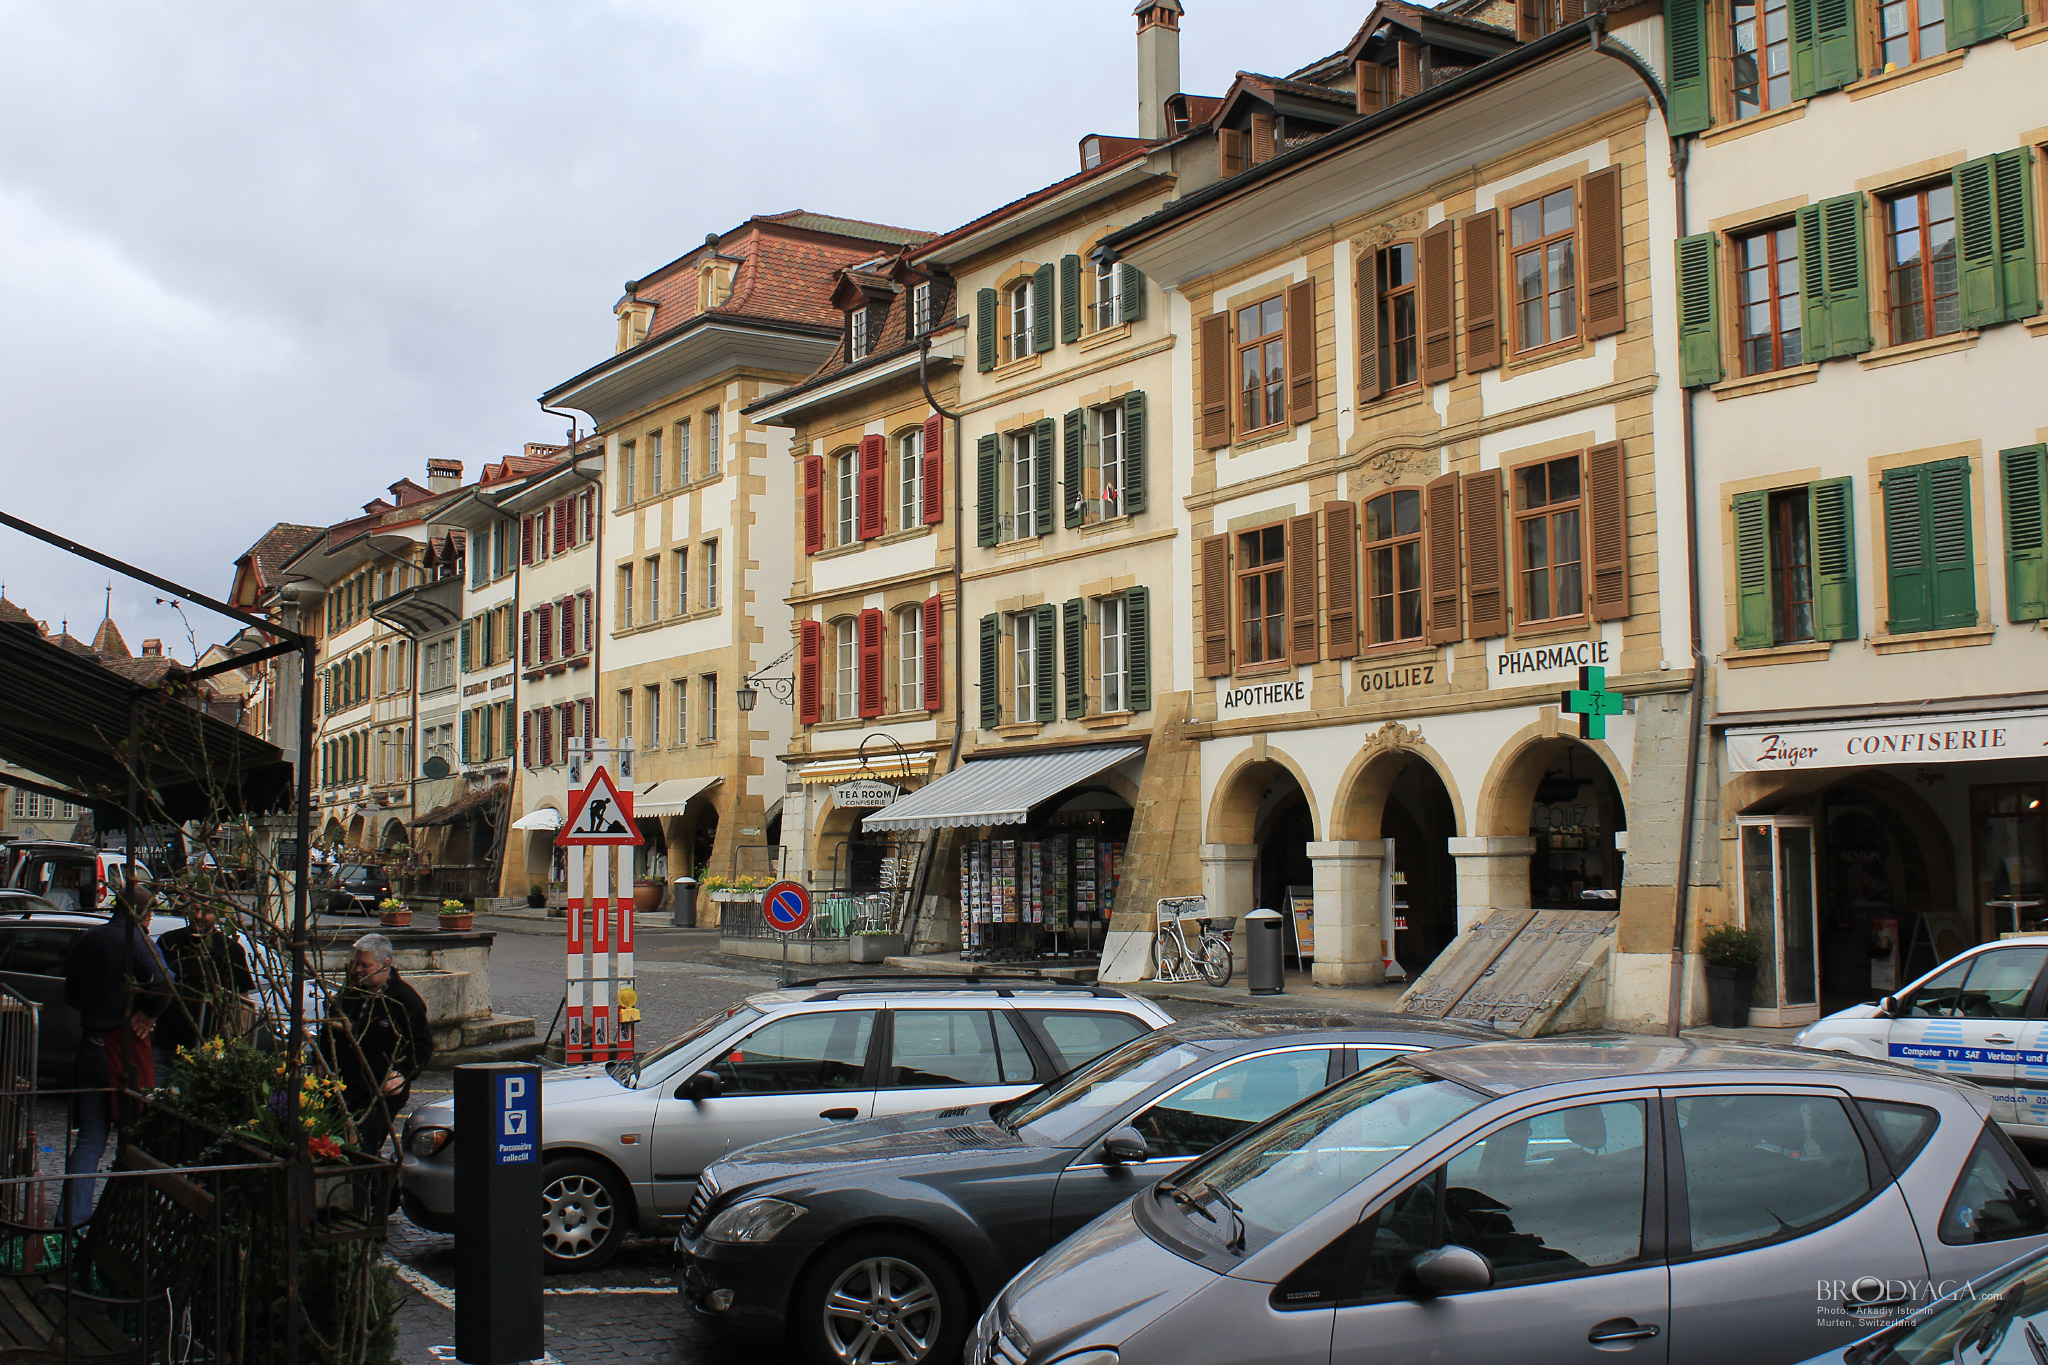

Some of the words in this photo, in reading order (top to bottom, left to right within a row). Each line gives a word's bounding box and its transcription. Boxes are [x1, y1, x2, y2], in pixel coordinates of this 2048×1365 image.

[1498, 641, 1609, 675] PHARMACIE
[1361, 666, 1434, 692] GOLLIEZ
[1224, 682, 1305, 708] APOTHEKE
[1756, 735, 1818, 767] Züger
[1846, 728, 2007, 755] CONFISERIE
[862, 791, 891, 799] ROOM
[1902, 1046, 1942, 1058] Computer
[1947, 1049, 1959, 1058] TV
[1965, 1051, 1981, 1059] SAT
[2026, 1053, 2042, 1063] und
[505, 1076, 525, 1110] P
[1992, 1094, 2027, 1104] unda.ch
[499, 1142, 532, 1153] Parcomètre
[502, 1152, 529, 1163] collectif
